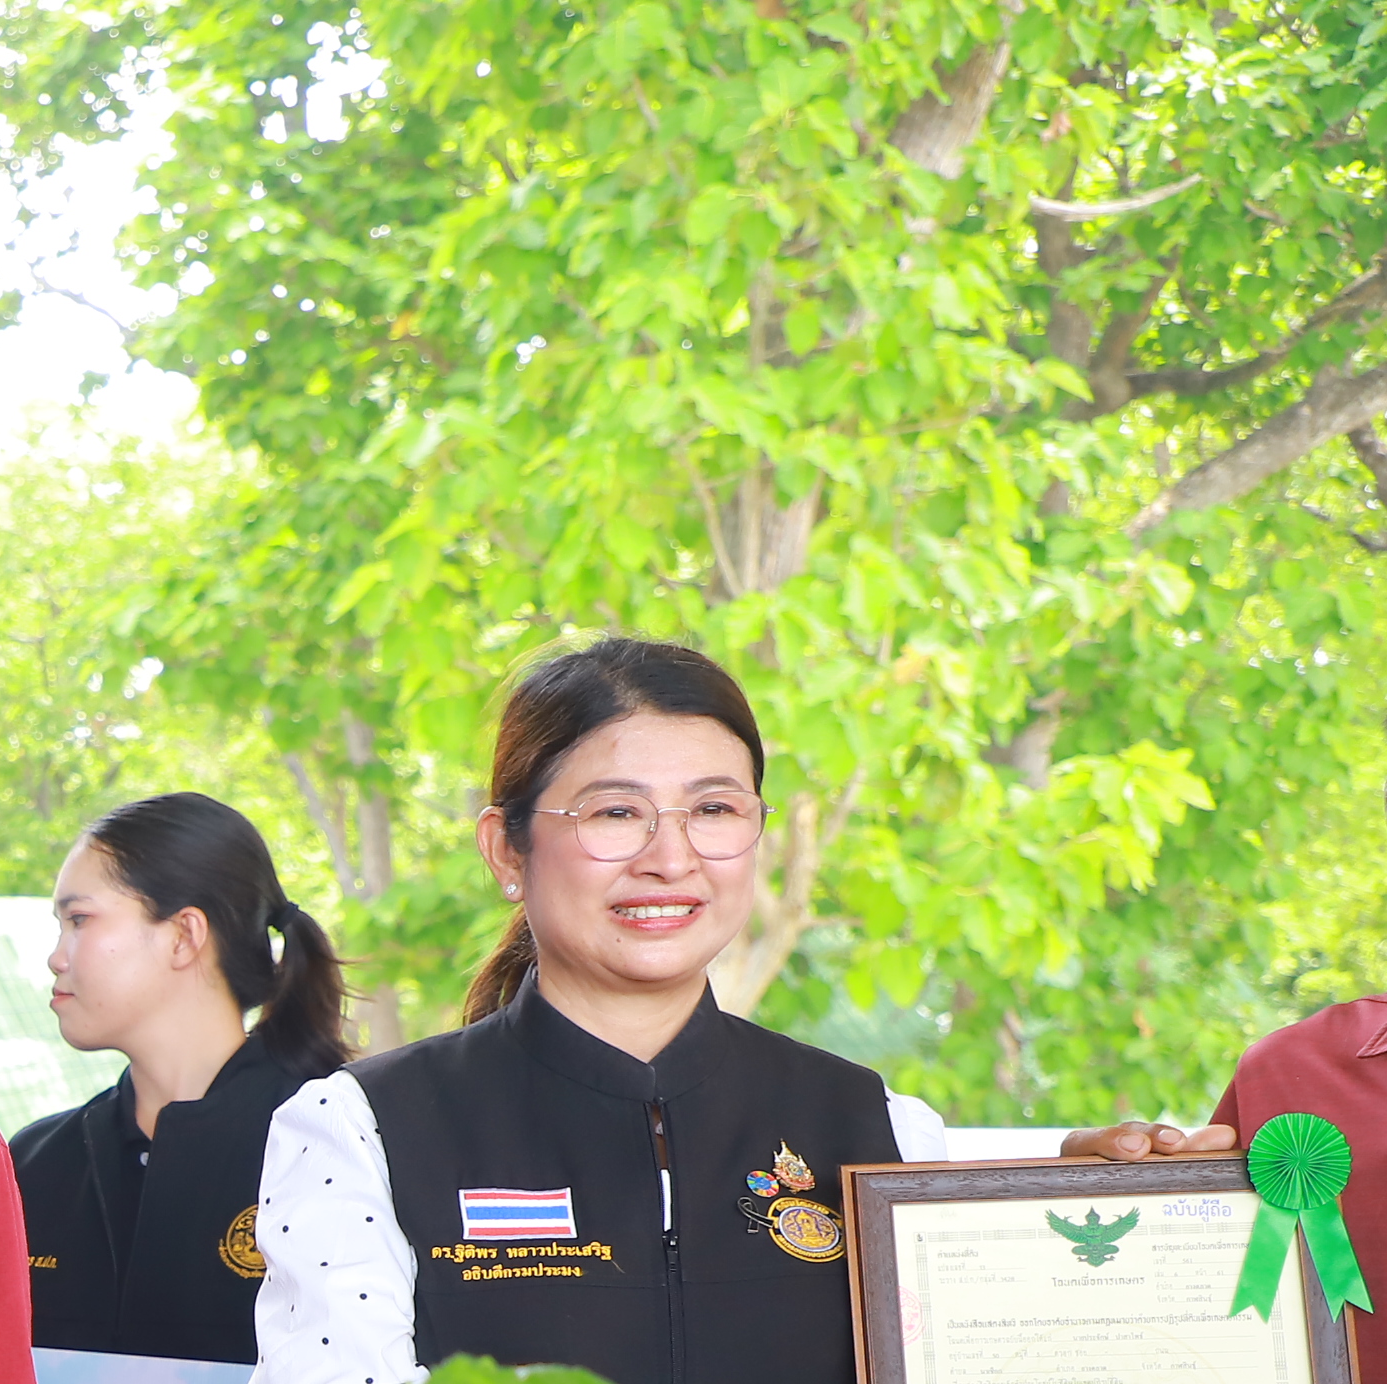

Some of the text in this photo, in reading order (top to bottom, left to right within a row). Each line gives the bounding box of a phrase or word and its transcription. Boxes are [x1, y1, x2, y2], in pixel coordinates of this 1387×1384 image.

[1162, 1199, 1232, 1222] ฉบับผู้ถือ
[506, 1242, 612, 1261] หลาวประเสริฐ
[462, 1263, 581, 1281] อธิบดีกรมประมง
[1052, 1273, 1146, 1288] โฉนดเพื่อการเกษตร
